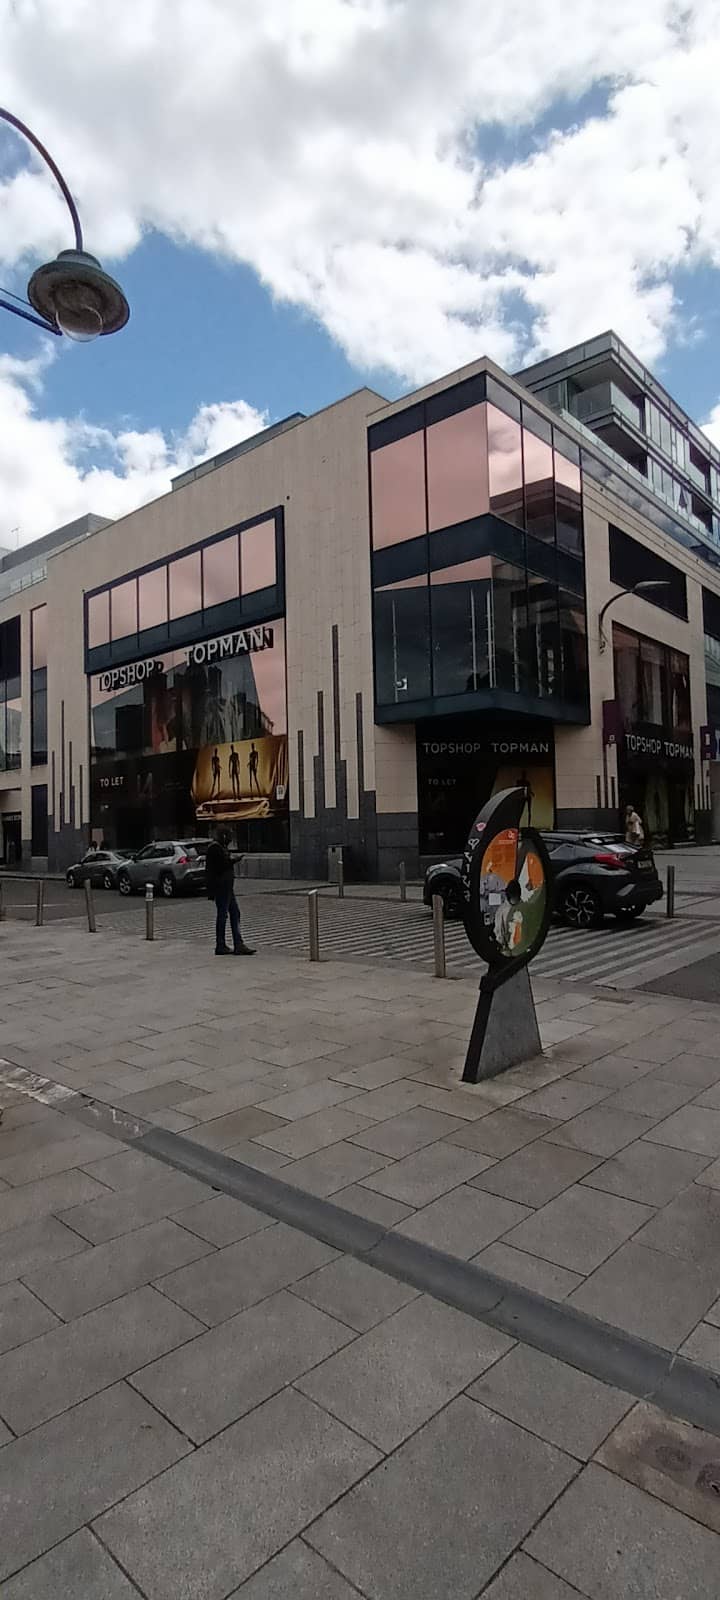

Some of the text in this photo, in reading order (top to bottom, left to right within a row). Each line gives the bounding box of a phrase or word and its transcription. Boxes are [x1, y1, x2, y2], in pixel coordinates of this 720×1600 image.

[98, 626, 264, 690] TOPSHOP TOPMAN
[423, 741, 549, 754] TOPSHOP TOPMAN
[624, 733, 662, 755] TOPSHOP
[99, 776, 124, 788] TO LET
